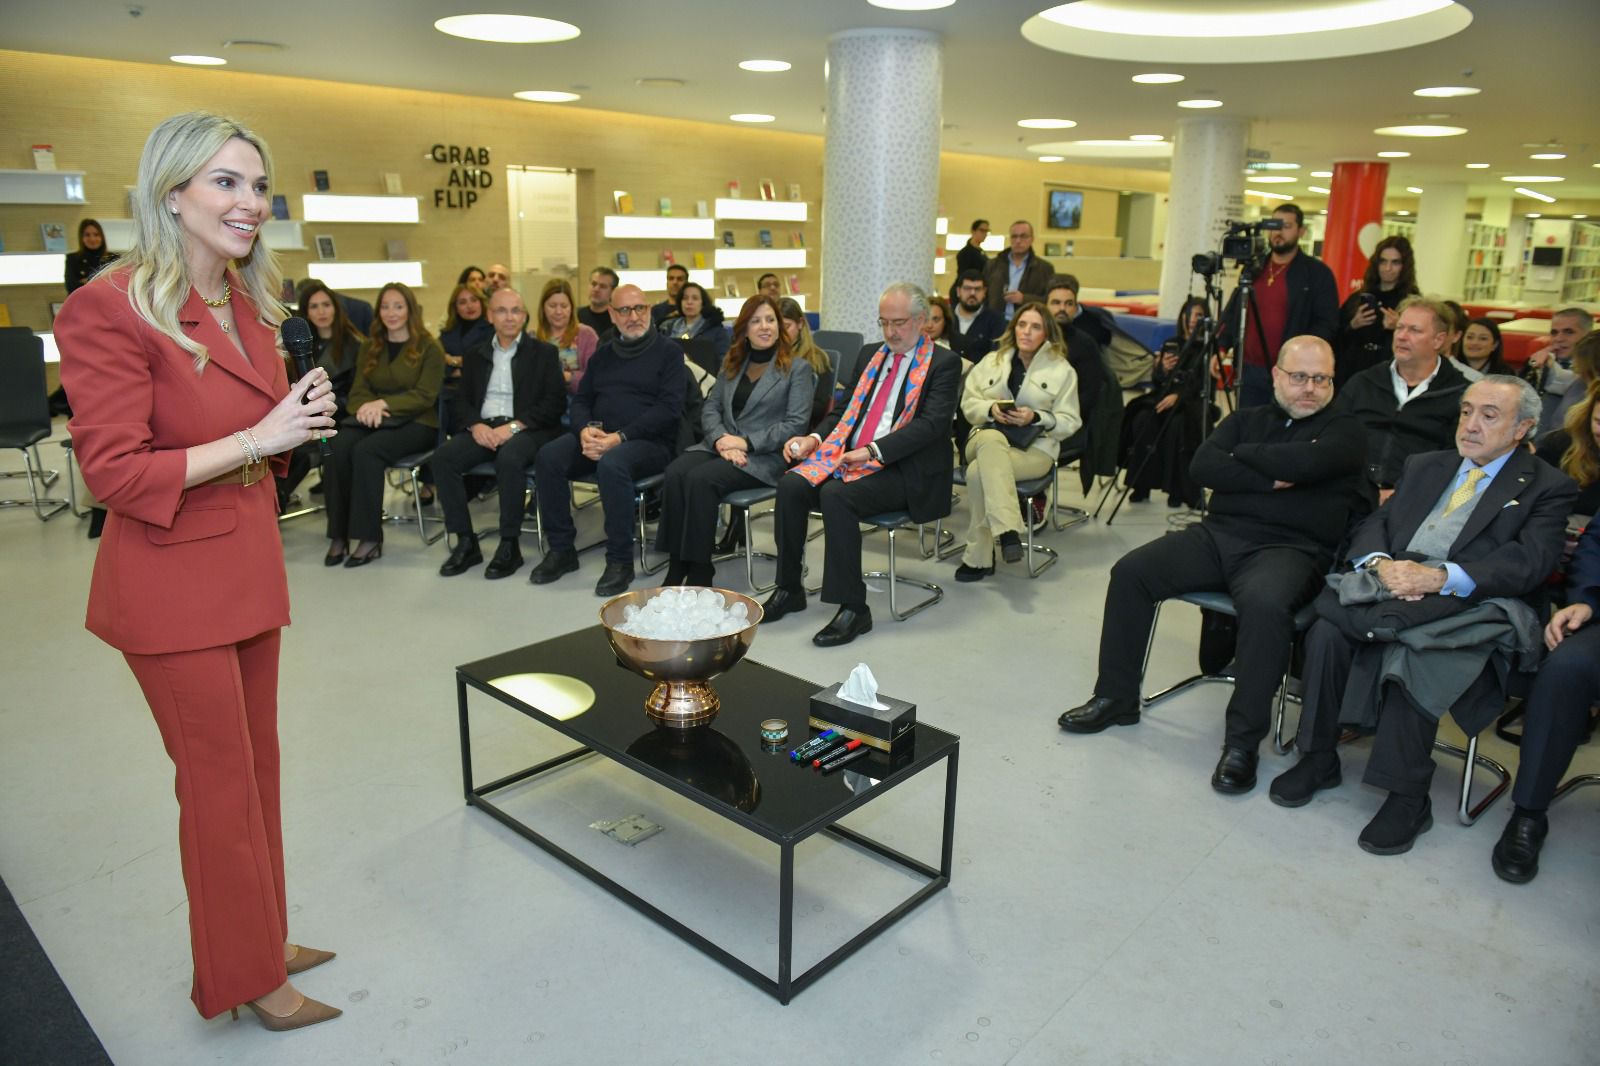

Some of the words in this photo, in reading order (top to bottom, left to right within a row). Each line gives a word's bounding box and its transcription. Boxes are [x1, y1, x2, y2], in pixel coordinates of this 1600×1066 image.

[432, 144, 490, 165] GRAB
[448, 168, 493, 188] AND
[434, 190, 478, 208] FLIP
